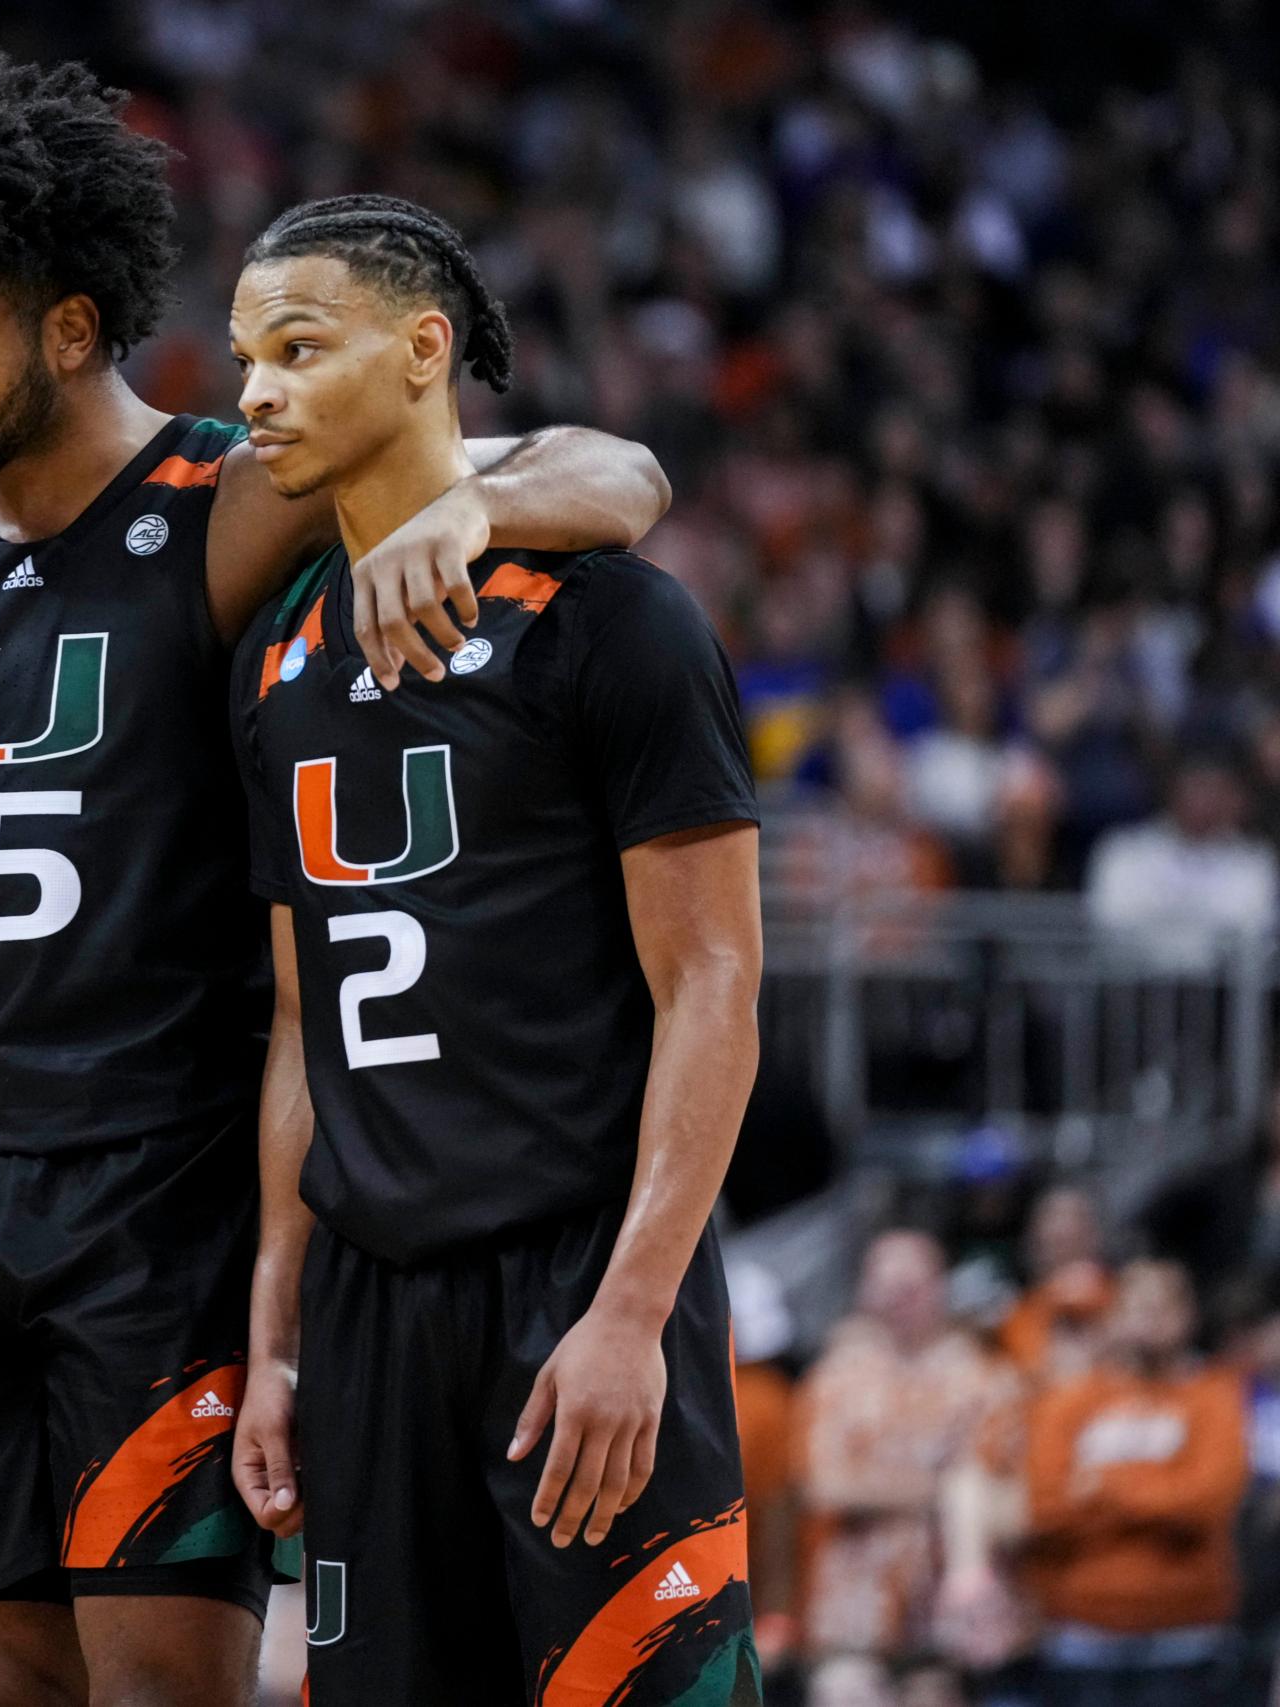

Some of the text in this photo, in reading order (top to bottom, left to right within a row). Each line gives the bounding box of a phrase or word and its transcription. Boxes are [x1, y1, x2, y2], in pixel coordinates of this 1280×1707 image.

[133, 528, 166, 538] ACC
[1, 574, 45, 591] adidas
[349, 687, 382, 703] adidas
[293, 744, 460, 886] U
[327, 909, 441, 1071] 2
[191, 1403, 235, 1418] adida
[654, 1583, 700, 1601] adidas
